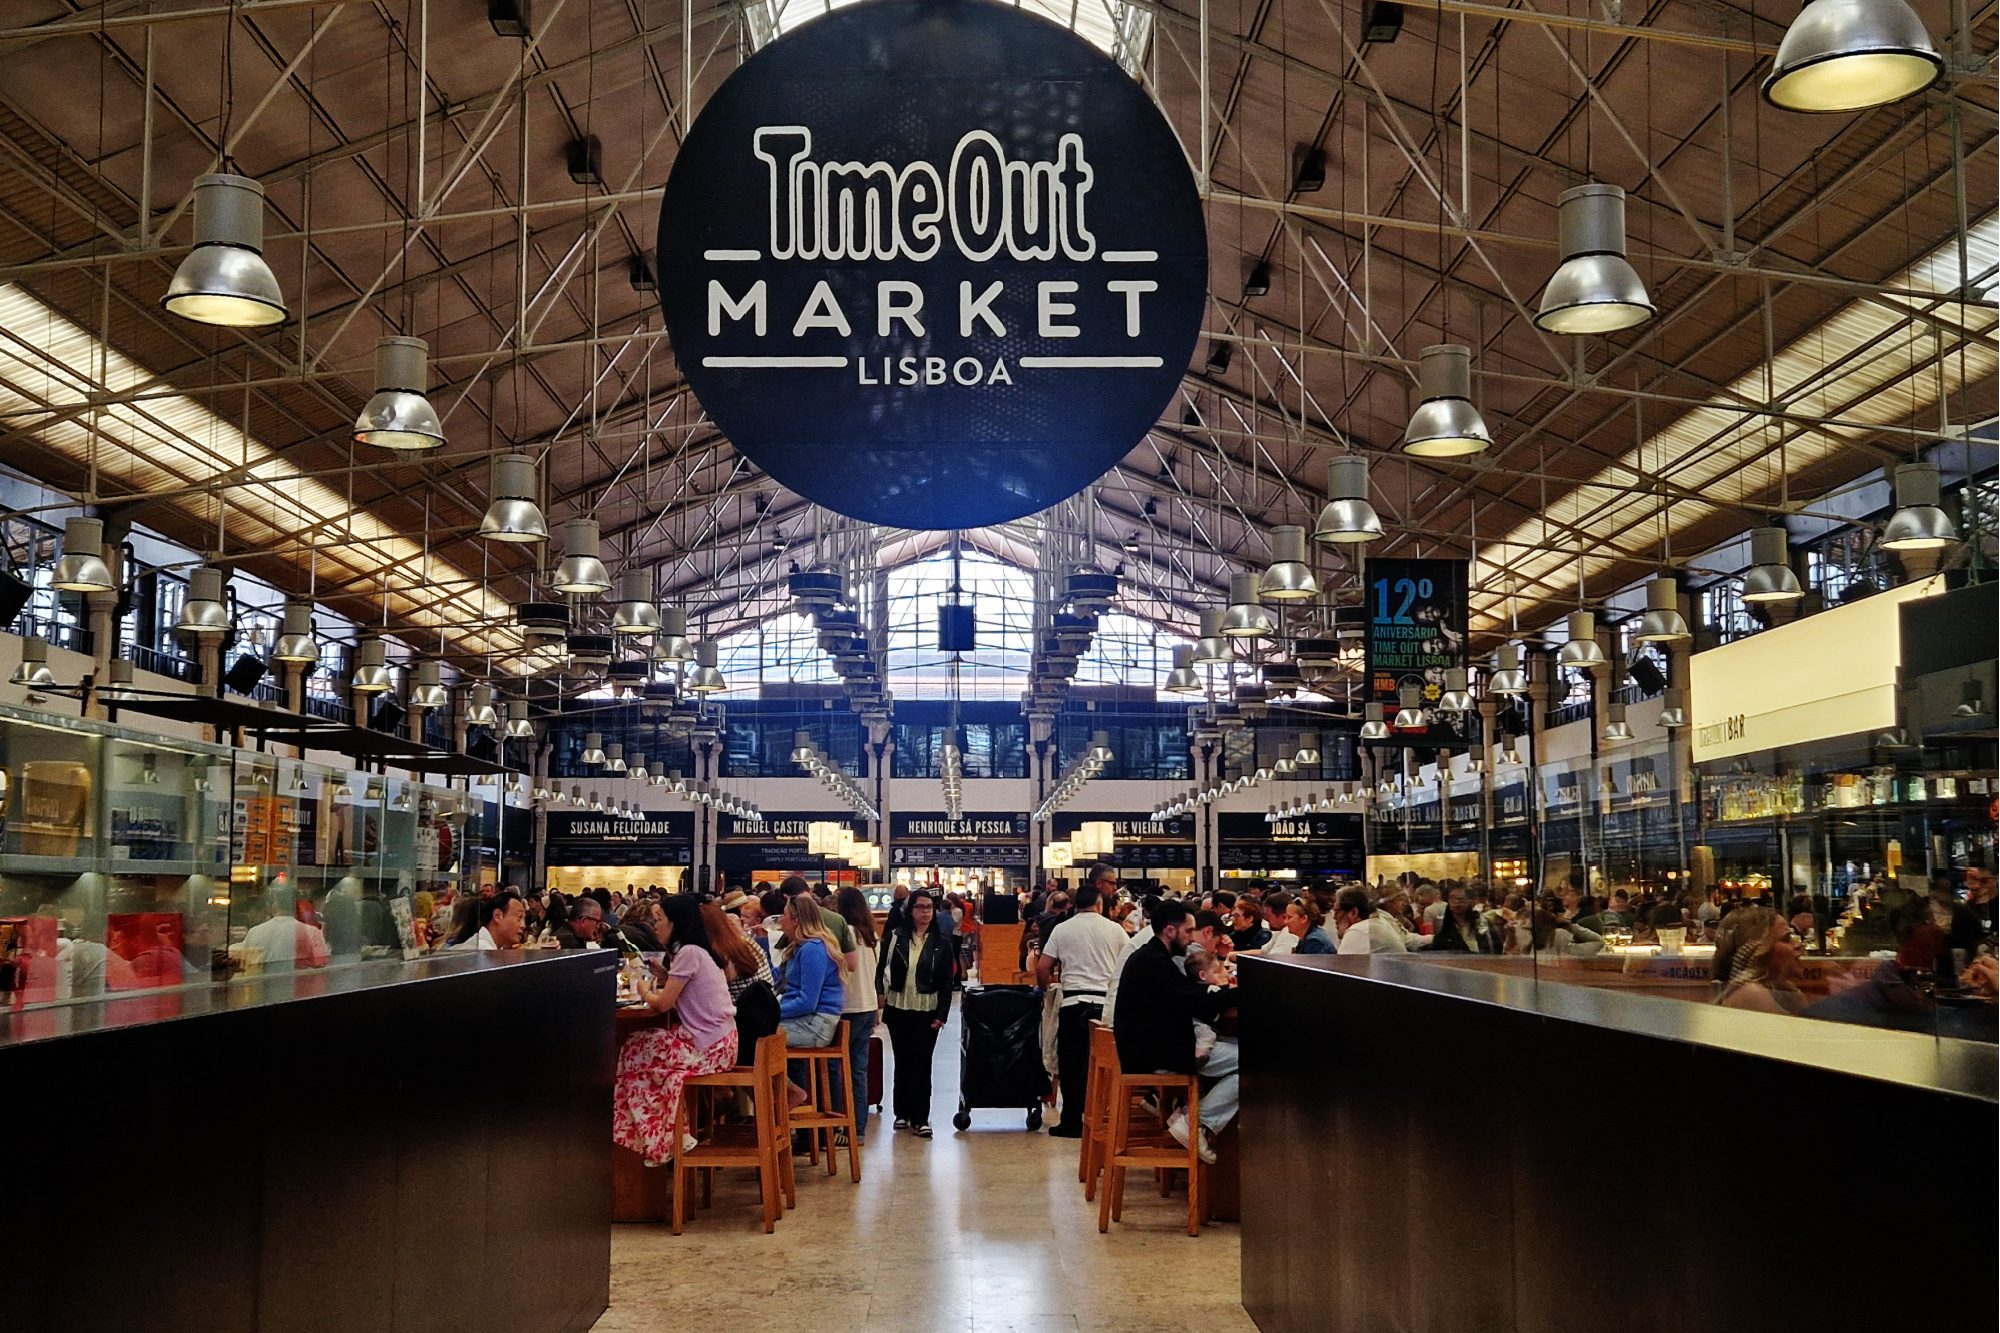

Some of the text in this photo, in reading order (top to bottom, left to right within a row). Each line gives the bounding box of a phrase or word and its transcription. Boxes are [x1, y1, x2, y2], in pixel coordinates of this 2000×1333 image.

[753, 126, 1096, 262] Time Out
[708, 280, 1158, 338] MARKET
[859, 356, 1013, 386] LISBOA
[1373, 641, 1419, 654] TIME OUT
[1373, 654, 1414, 667] MARKET
[1374, 678, 1396, 691] HMB
[1728, 714, 1745, 740] BAR
[570, 821, 670, 834] SUSANA FELICIDADE
[733, 820, 809, 834] MIGUEL CASTRO
[908, 820, 956, 834] HENRIQUE
[959, 818, 972, 834] SÁ
[975, 820, 1011, 834] PESSOA
[1130, 821, 1165, 834] VIEIRA
[1271, 820, 1295, 835] JOÃO
[1298, 820, 1311, 835] SÁ
